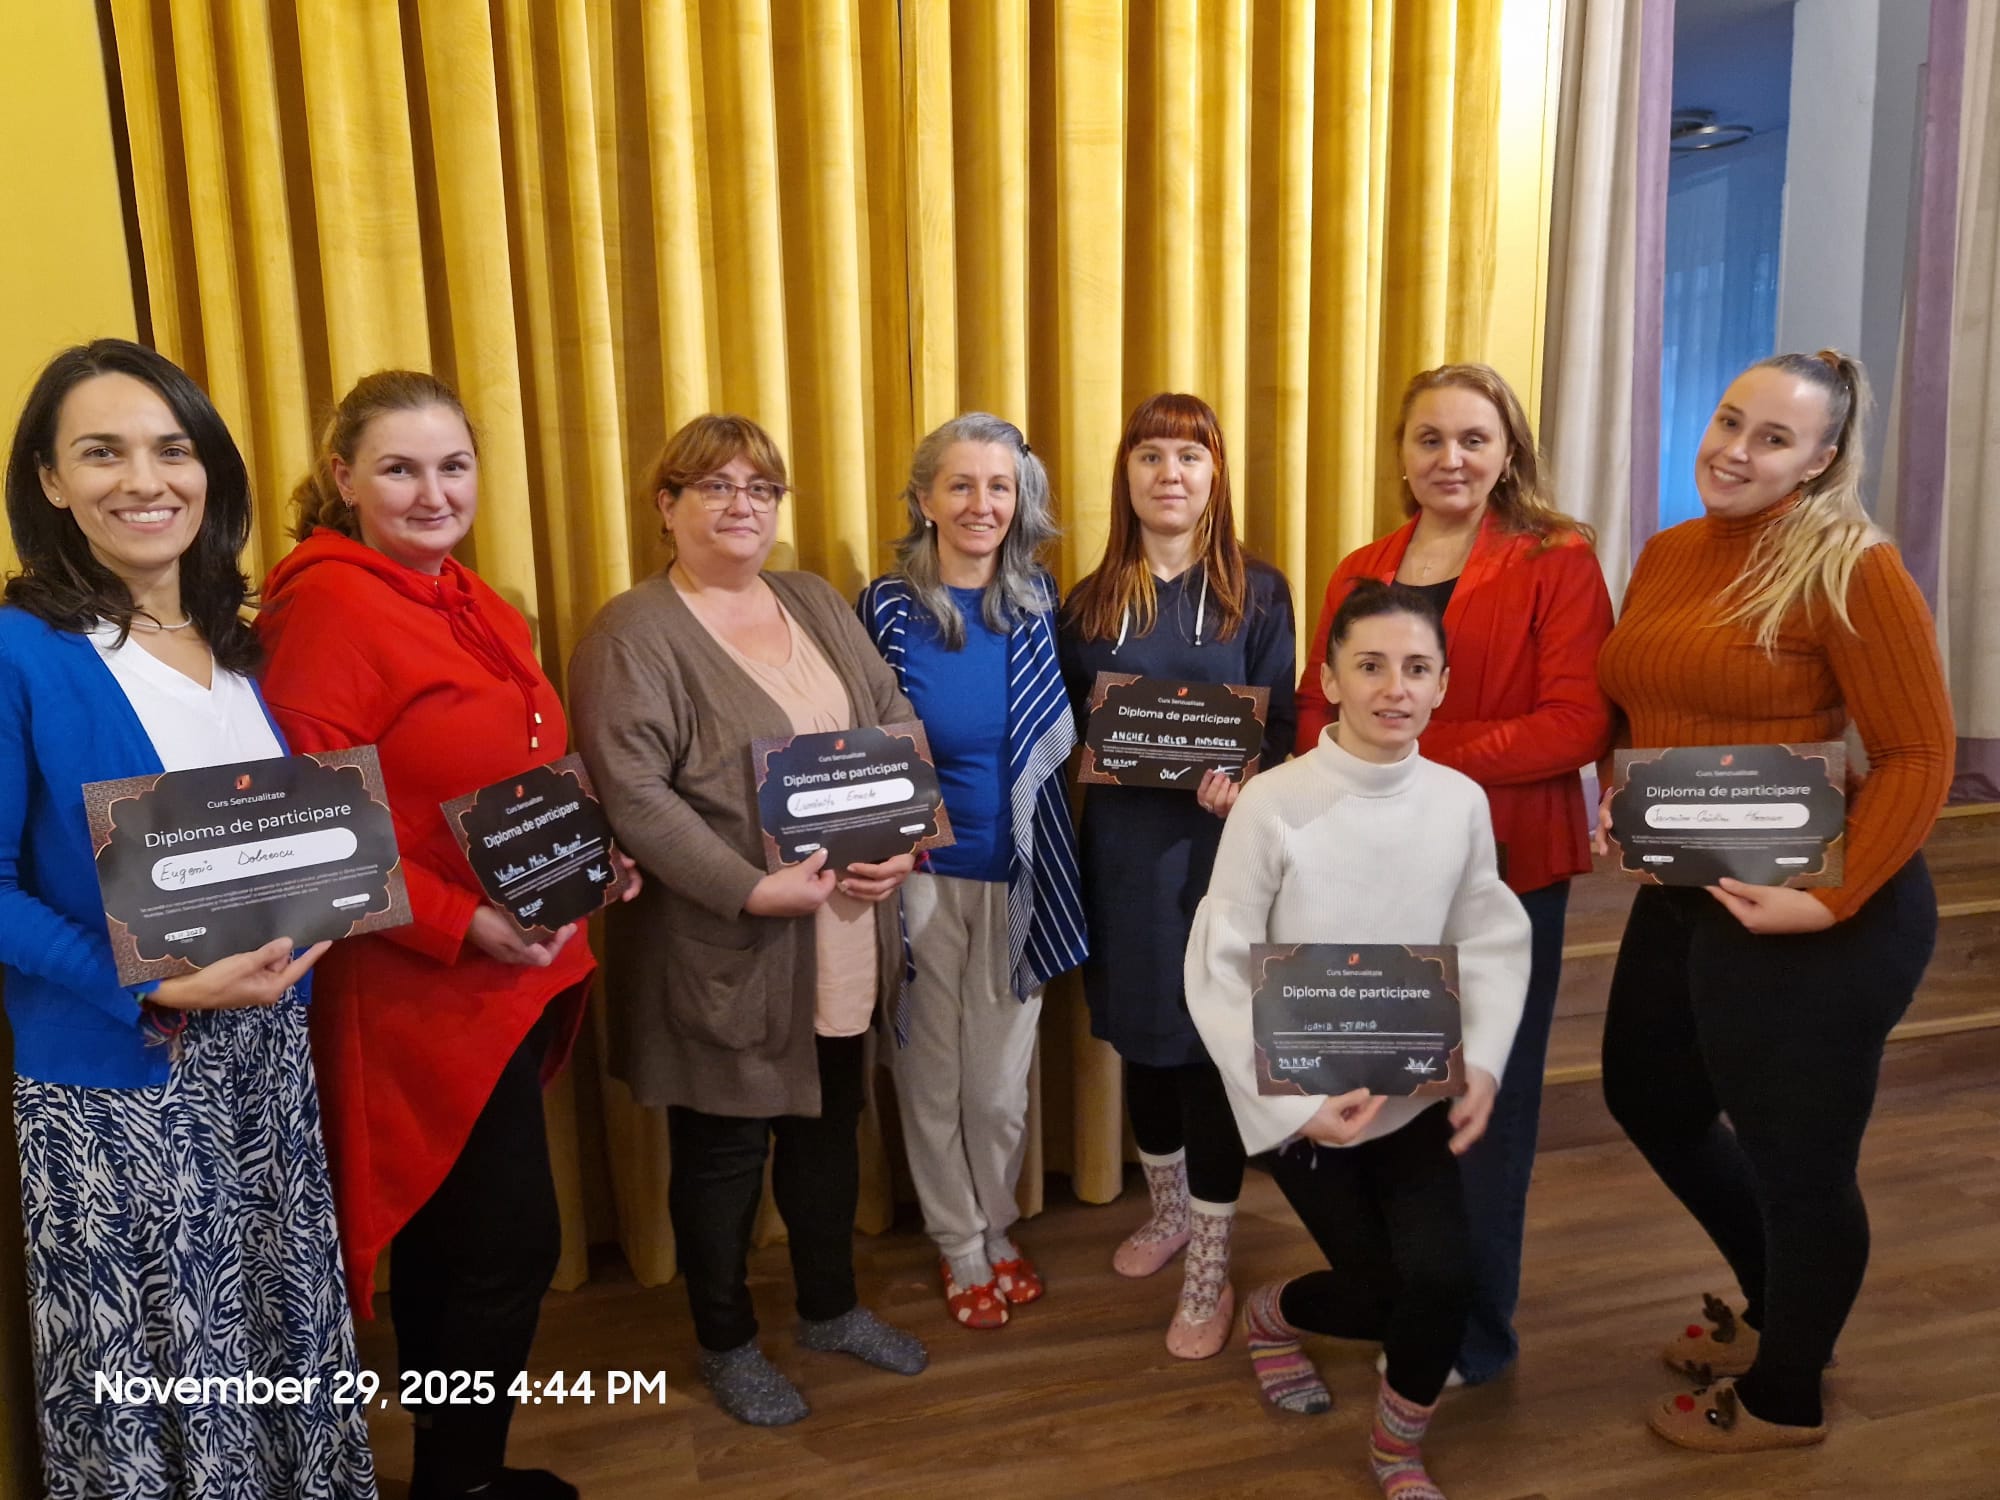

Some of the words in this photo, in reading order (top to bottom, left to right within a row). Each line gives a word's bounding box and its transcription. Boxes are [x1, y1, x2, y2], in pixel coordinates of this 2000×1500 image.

[1118, 706, 1164, 720] Diploma
[1166, 710, 1180, 720] de
[1182, 713, 1241, 725] participare
[783, 770, 830, 788] Diploma
[832, 769, 847, 781] de
[849, 761, 909, 780] participare
[207, 800, 229, 809] Curs
[230, 790, 286, 806] Senzualitate
[1646, 786, 1706, 798] Diploma
[1709, 785, 1728, 797] de
[1731, 784, 1811, 798] participare
[144, 823, 225, 848] Diploma
[230, 818, 253, 833] de
[258, 804, 352, 832] participare
[483, 825, 523, 849] Diploma
[522, 819, 535, 832] de
[534, 801, 580, 829] participare
[160, 860, 213, 884] Eugenia
[238, 848, 295, 866] Dobrescu
[1326, 969, 1341, 977] Curs
[1283, 985, 1336, 999] Diploma
[1339, 986, 1356, 998] de
[1359, 987, 1431, 1000] participare
